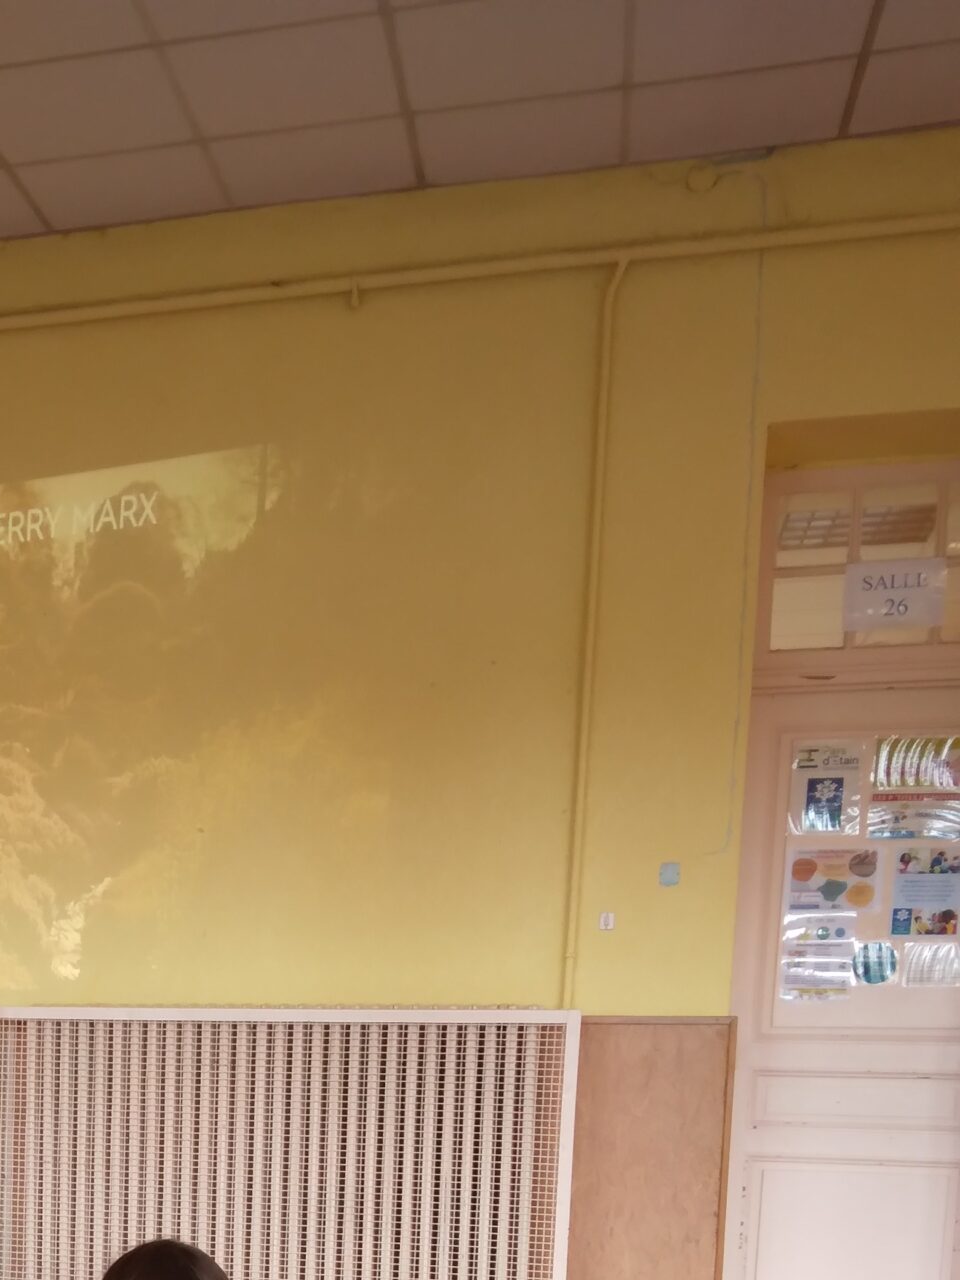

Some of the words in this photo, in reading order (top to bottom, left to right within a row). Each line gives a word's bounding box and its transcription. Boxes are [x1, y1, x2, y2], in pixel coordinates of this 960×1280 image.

[72, 491, 159, 534] MARX
[862, 571, 928, 592] SALLE
[883, 598, 908, 616] 26
